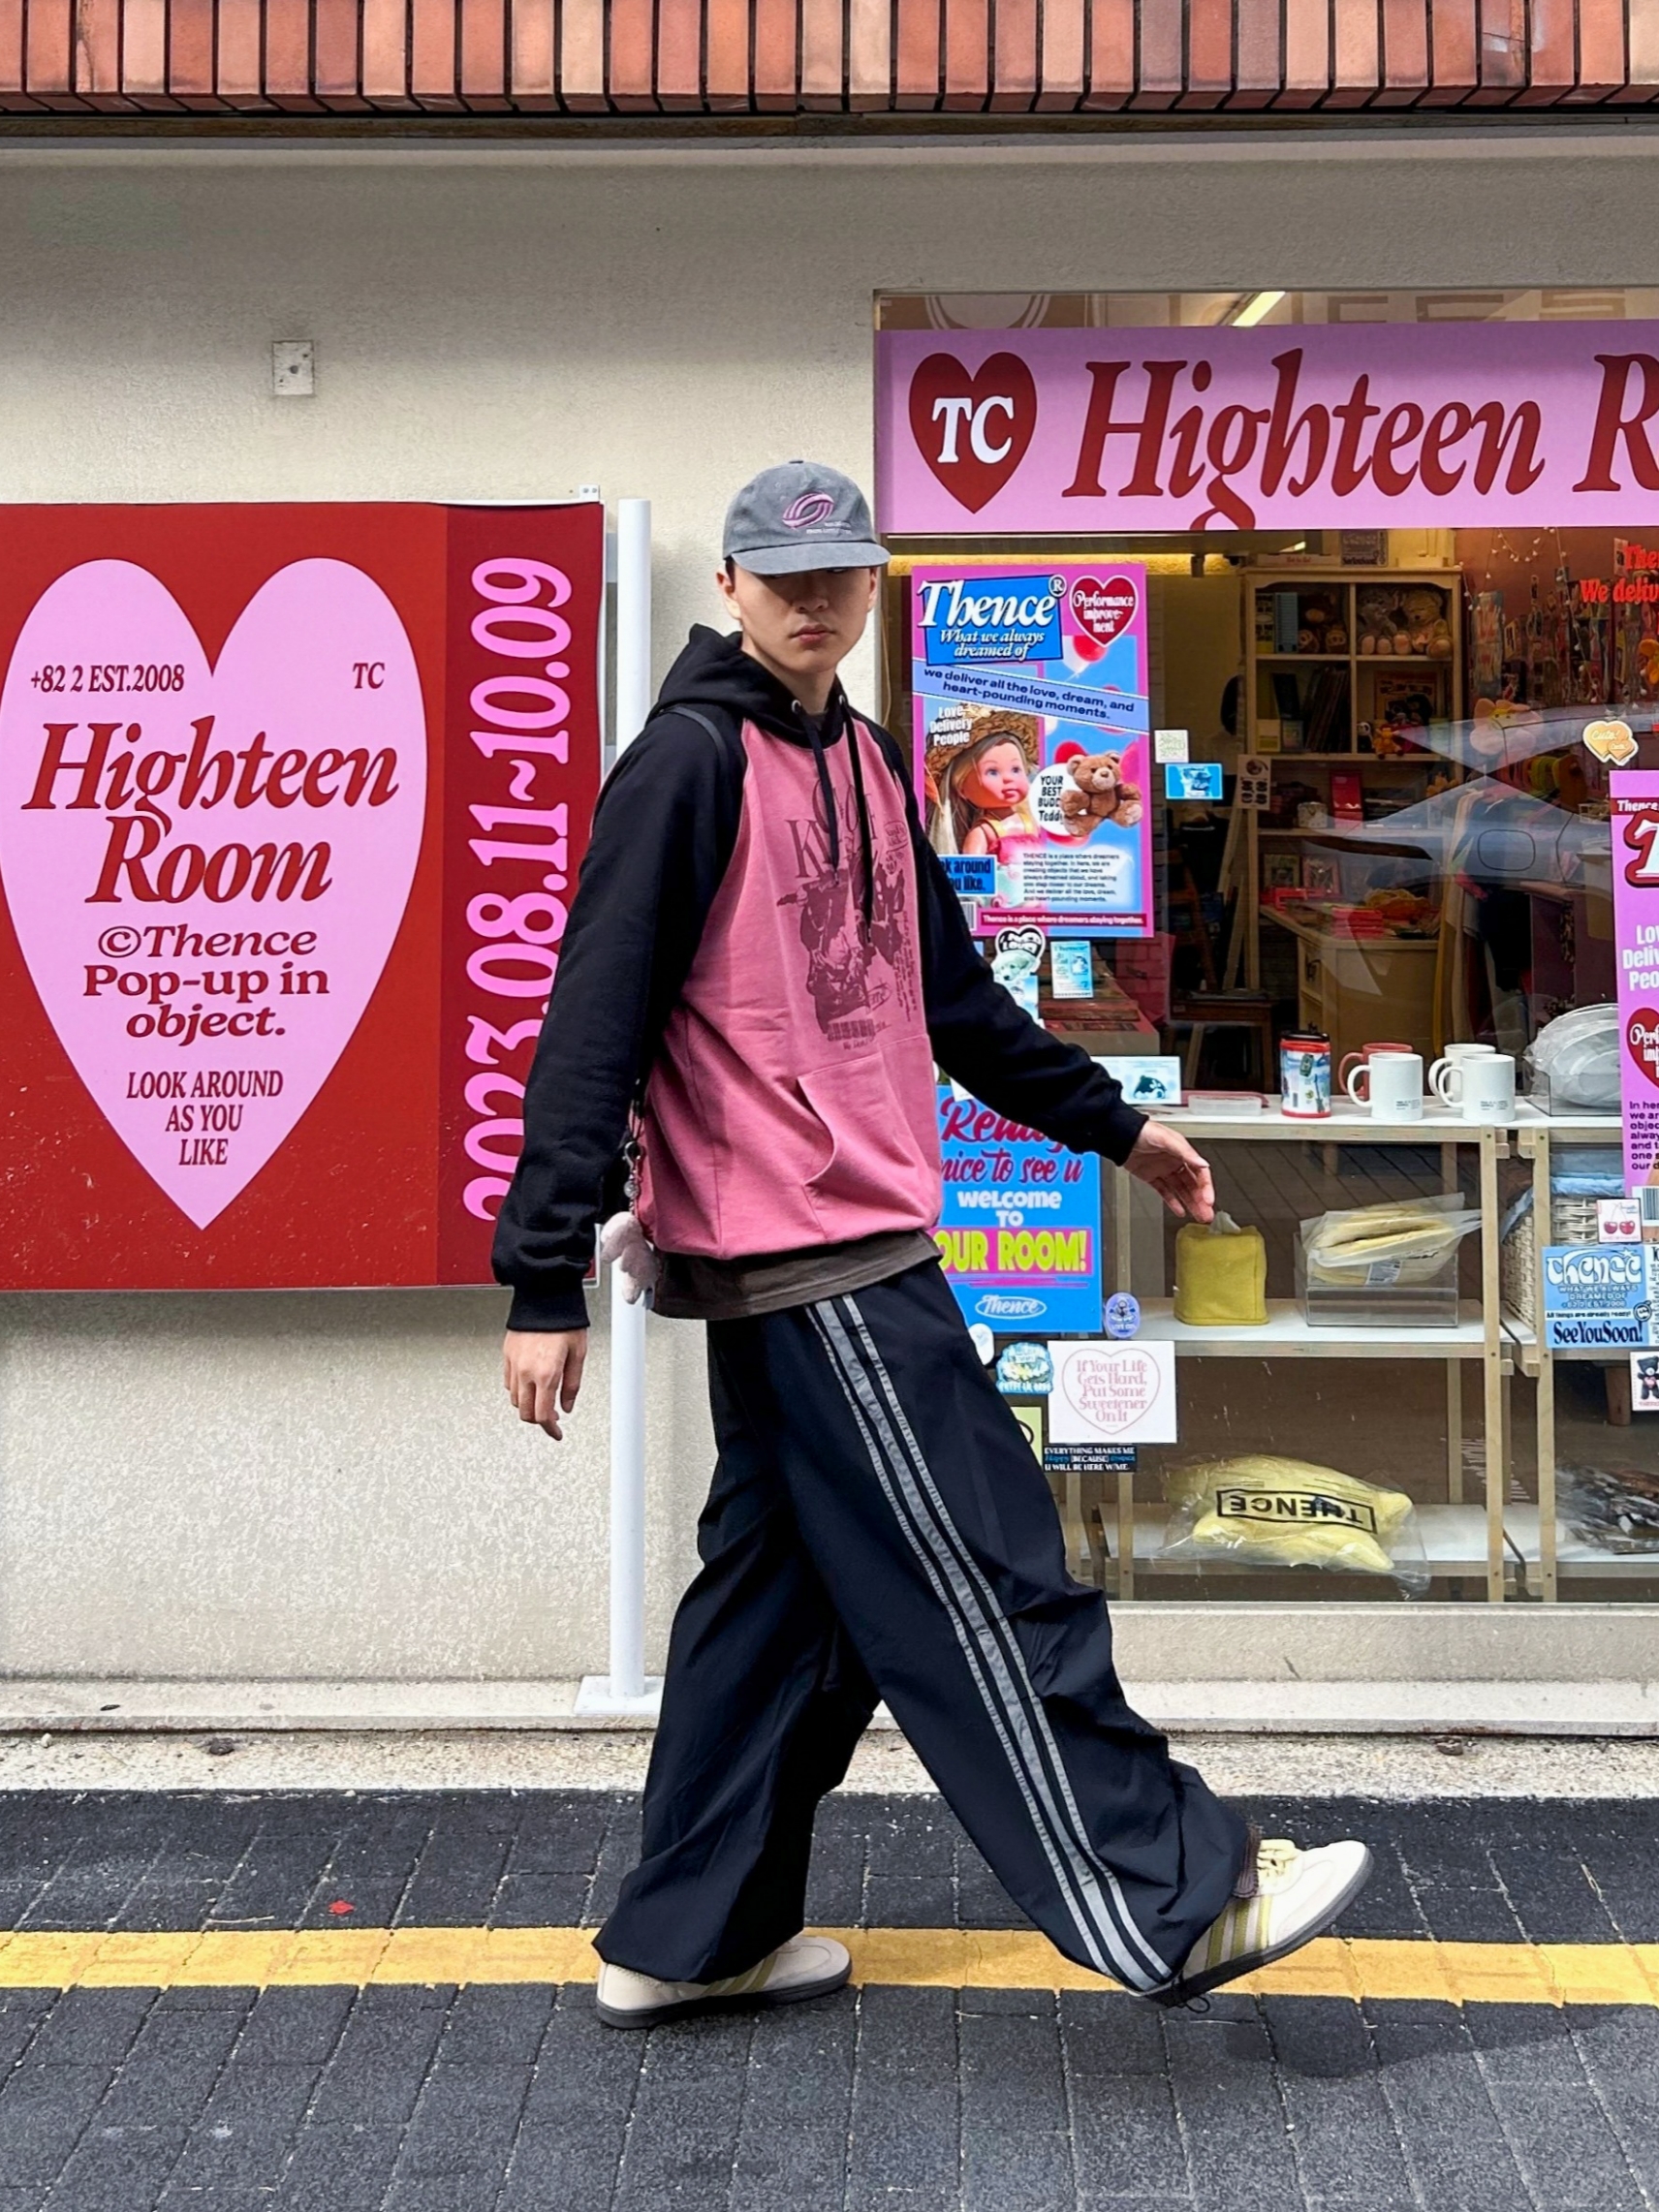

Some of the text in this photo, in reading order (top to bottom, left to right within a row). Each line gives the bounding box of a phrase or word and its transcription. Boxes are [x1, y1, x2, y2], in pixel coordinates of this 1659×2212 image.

[931, 395, 1015, 465] TC
[1061, 347, 1546, 529] Highteen
[1074, 590, 1134, 608] Performance
[1580, 578, 1609, 603] We
[940, 629, 1045, 644] What we always
[955, 643, 1031, 662] dreamed of
[30, 664, 185, 693] +82 2 EST.2008
[353, 663, 385, 689] TC
[923, 669, 1134, 712] we deliver all the love, dream, and
[943, 681, 1111, 720] heart-pounding moments.
[929, 717, 973, 732] Delivery
[933, 732, 970, 747] People
[21, 715, 399, 835] Highteen
[1040, 775, 1064, 786] YOUR
[1041, 786, 1063, 796] BEST
[1038, 797, 1061, 808] BUD
[85, 814, 332, 904] Room
[954, 857, 990, 874] around
[963, 875, 986, 891] like.
[83, 964, 329, 1003] Pop-up in
[126, 1004, 287, 1046] object.
[126, 1070, 283, 1099] LOOK AROUND
[1629, 1101, 1659, 1109] In he
[165, 1105, 243, 1132] AS YOU
[178, 1138, 229, 1167] LIKE
[1631, 1141, 1652, 1150] and
[981, 1147, 1015, 1183] to
[1019, 1157, 1059, 1183] see
[1063, 1159, 1084, 1183] u
[995, 1210, 1024, 1229] TO
[998, 1230, 1087, 1272] ROOM!
[980, 1294, 1040, 1315] Thence
[1077, 1358, 1147, 1372] If Your Life
[1077, 1372, 1147, 1386] Gets Hard,
[1082, 1385, 1145, 1397] Put Some
[1079, 1396, 1147, 1411] Sweetener
[1095, 1409, 1128, 1422] On It
